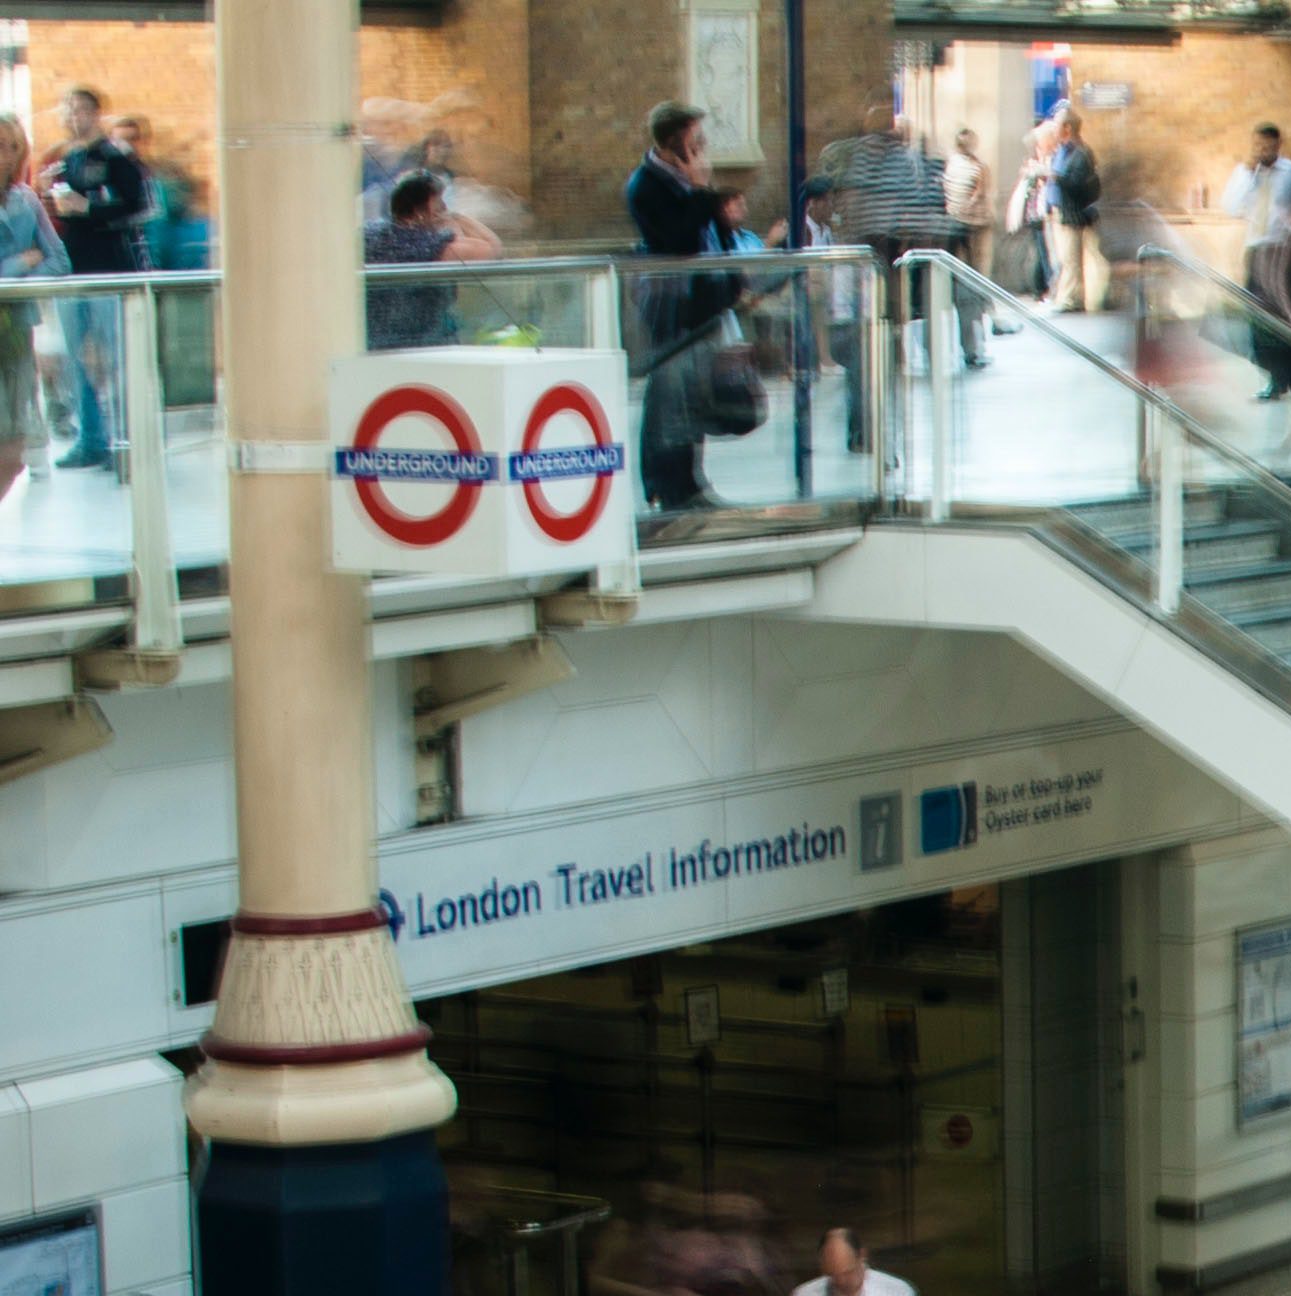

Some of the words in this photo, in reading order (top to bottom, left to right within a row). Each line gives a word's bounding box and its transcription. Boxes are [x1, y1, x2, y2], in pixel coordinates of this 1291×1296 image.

[345, 451, 491, 476] UNDERGROUND
[515, 448, 619, 475] UNDERGROUND
[416, 876, 541, 938] London
[555, 851, 654, 905] Travel
[668, 820, 847, 890] Information
